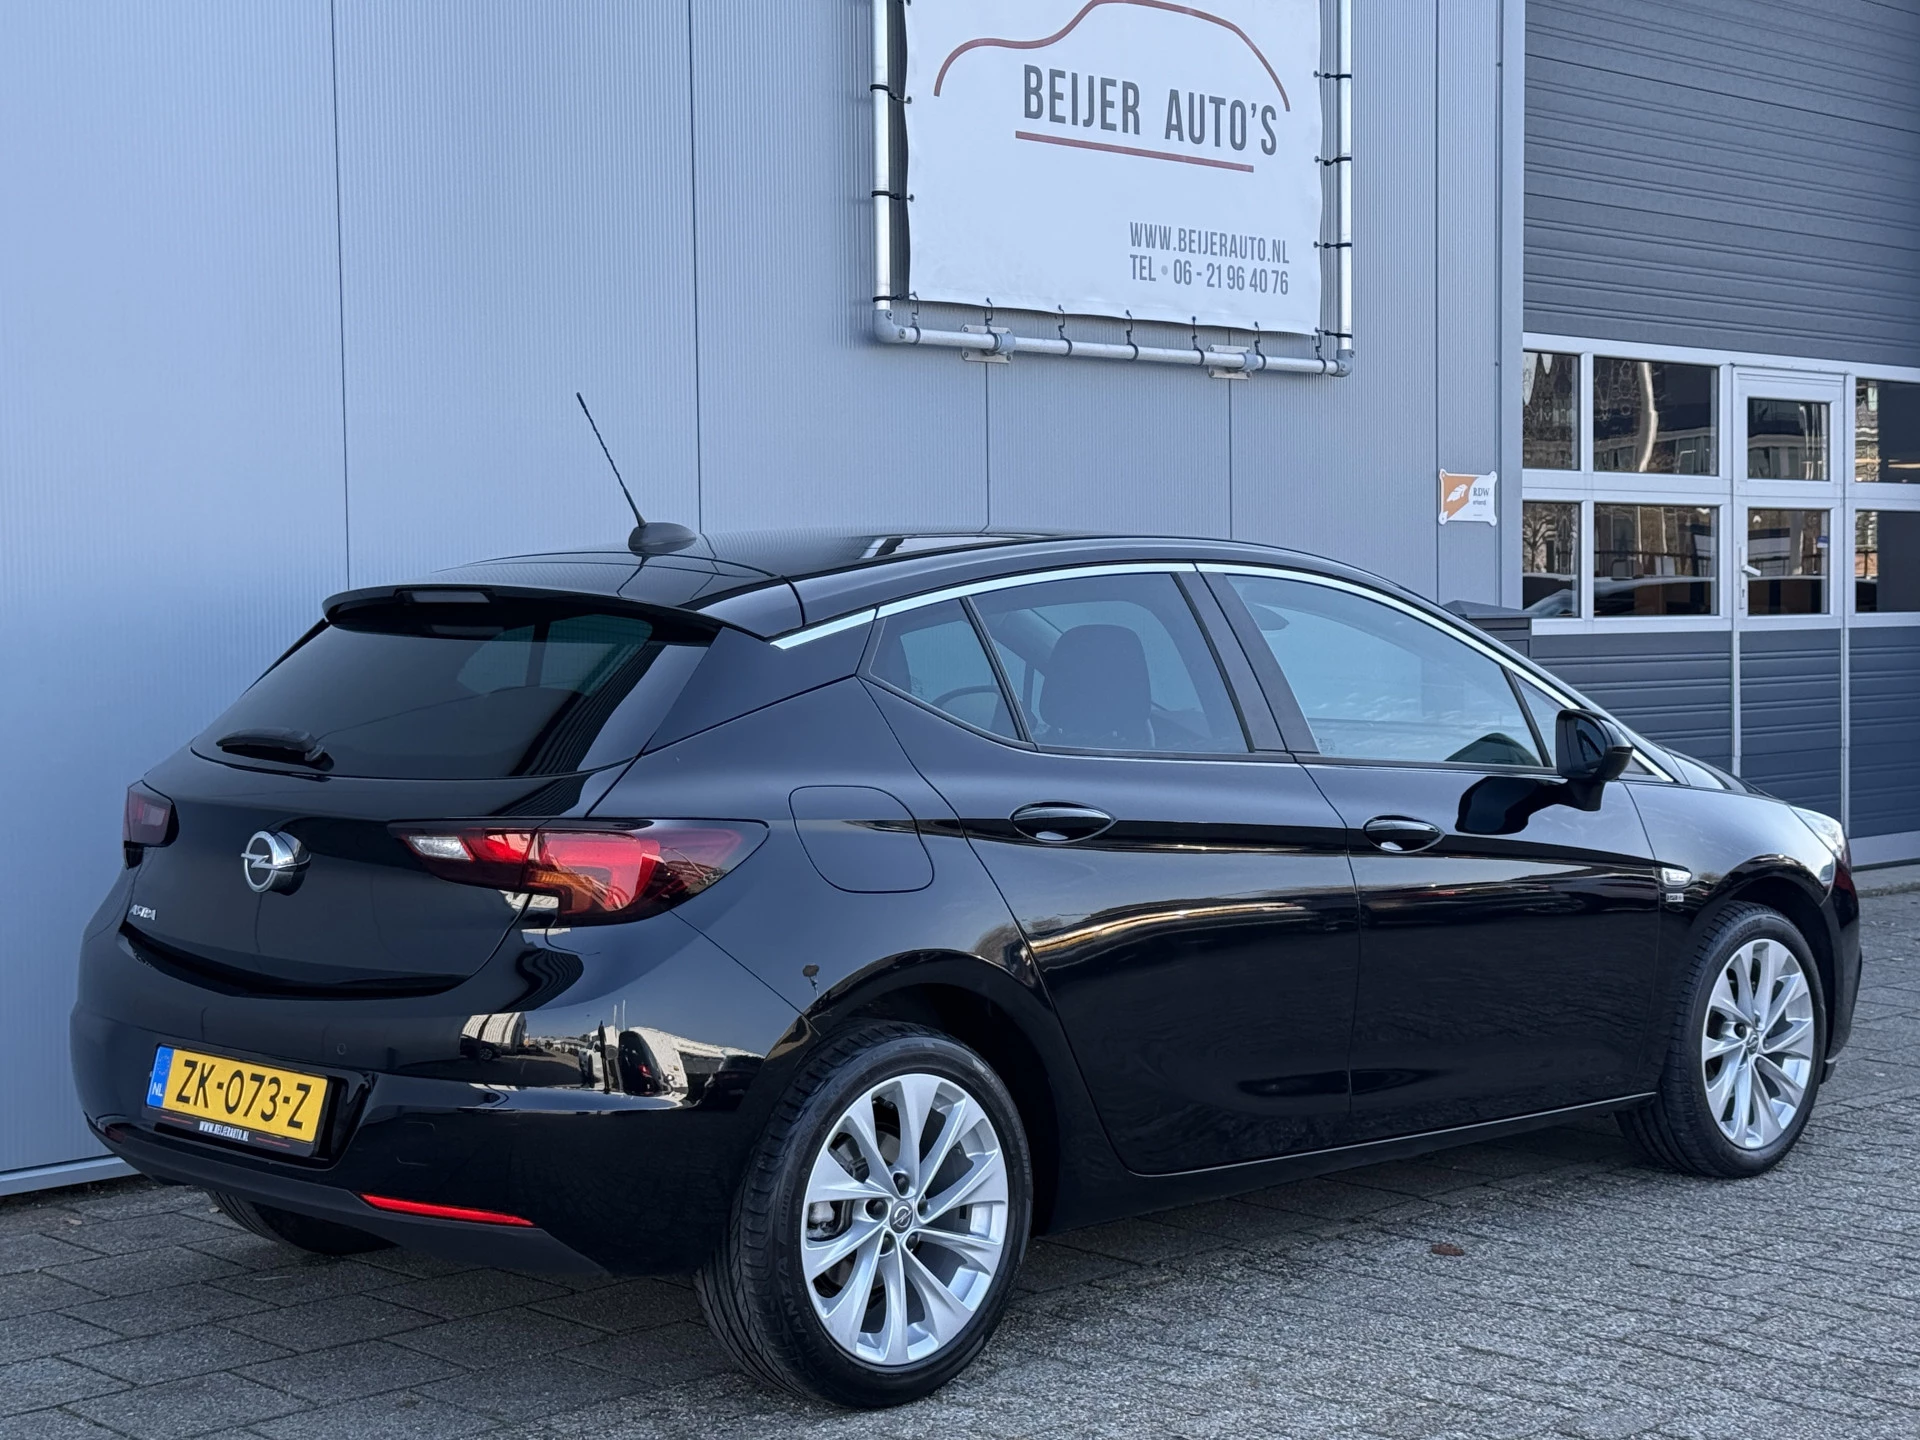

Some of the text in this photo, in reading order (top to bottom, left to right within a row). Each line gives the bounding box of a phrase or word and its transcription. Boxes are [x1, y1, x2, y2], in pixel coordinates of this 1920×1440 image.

[1024, 64, 1278, 156] BEIJER AUTO'S
[1129, 221, 1290, 264] WWW.BEIJERAUTO.NL
[1129, 254, 1157, 282] TEL
[1173, 258, 1192, 286] 06
[152, 1081, 163, 1097] NL
[175, 1058, 312, 1131] ZK-073-Z
